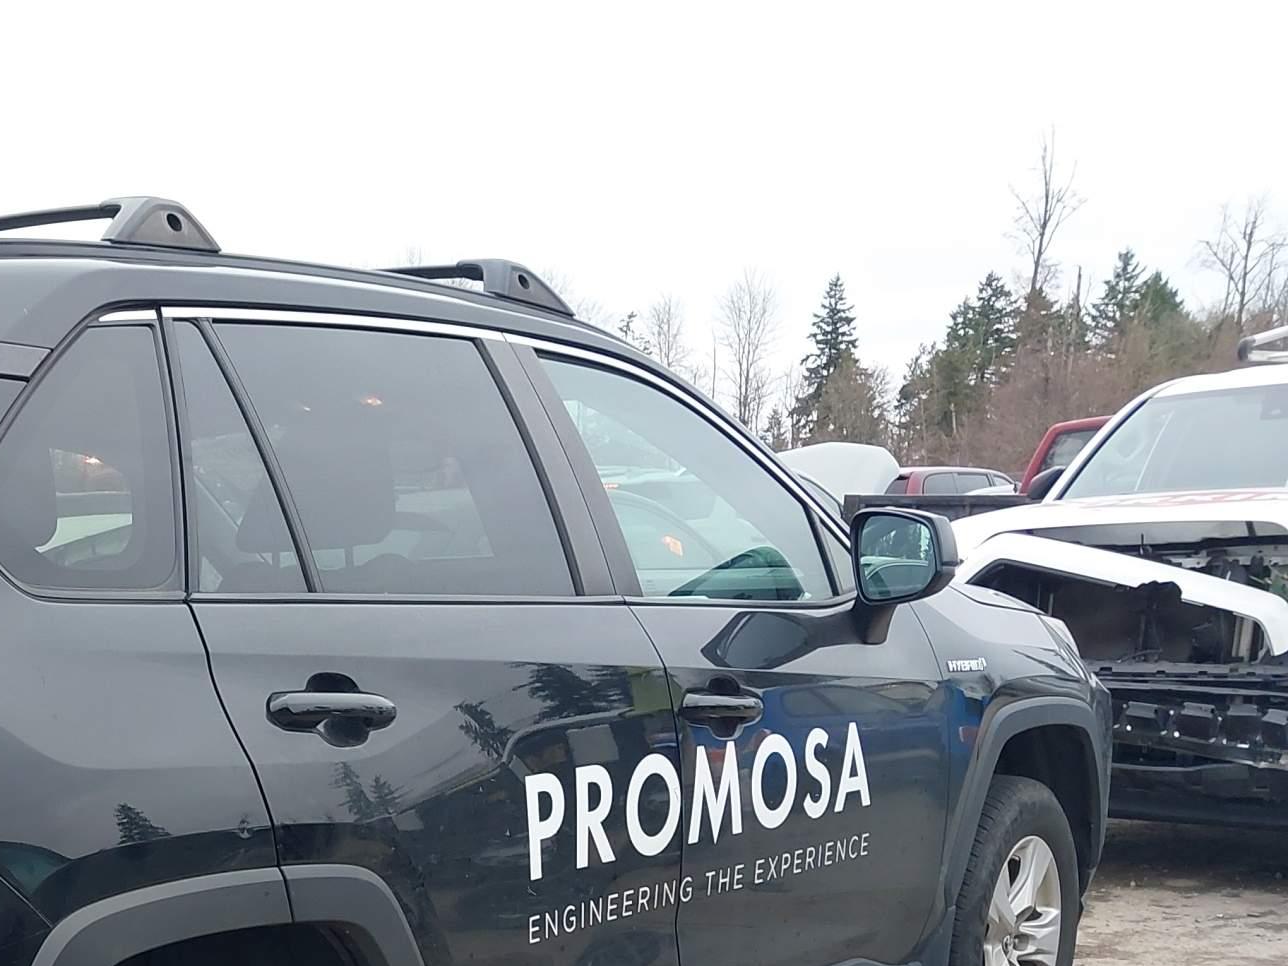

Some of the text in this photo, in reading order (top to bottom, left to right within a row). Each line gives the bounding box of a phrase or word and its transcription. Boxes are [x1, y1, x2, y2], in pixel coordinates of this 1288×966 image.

[524, 721, 872, 882] PROMOSA
[528, 832, 871, 944] ENGINEERING THE EXPERIENCE
